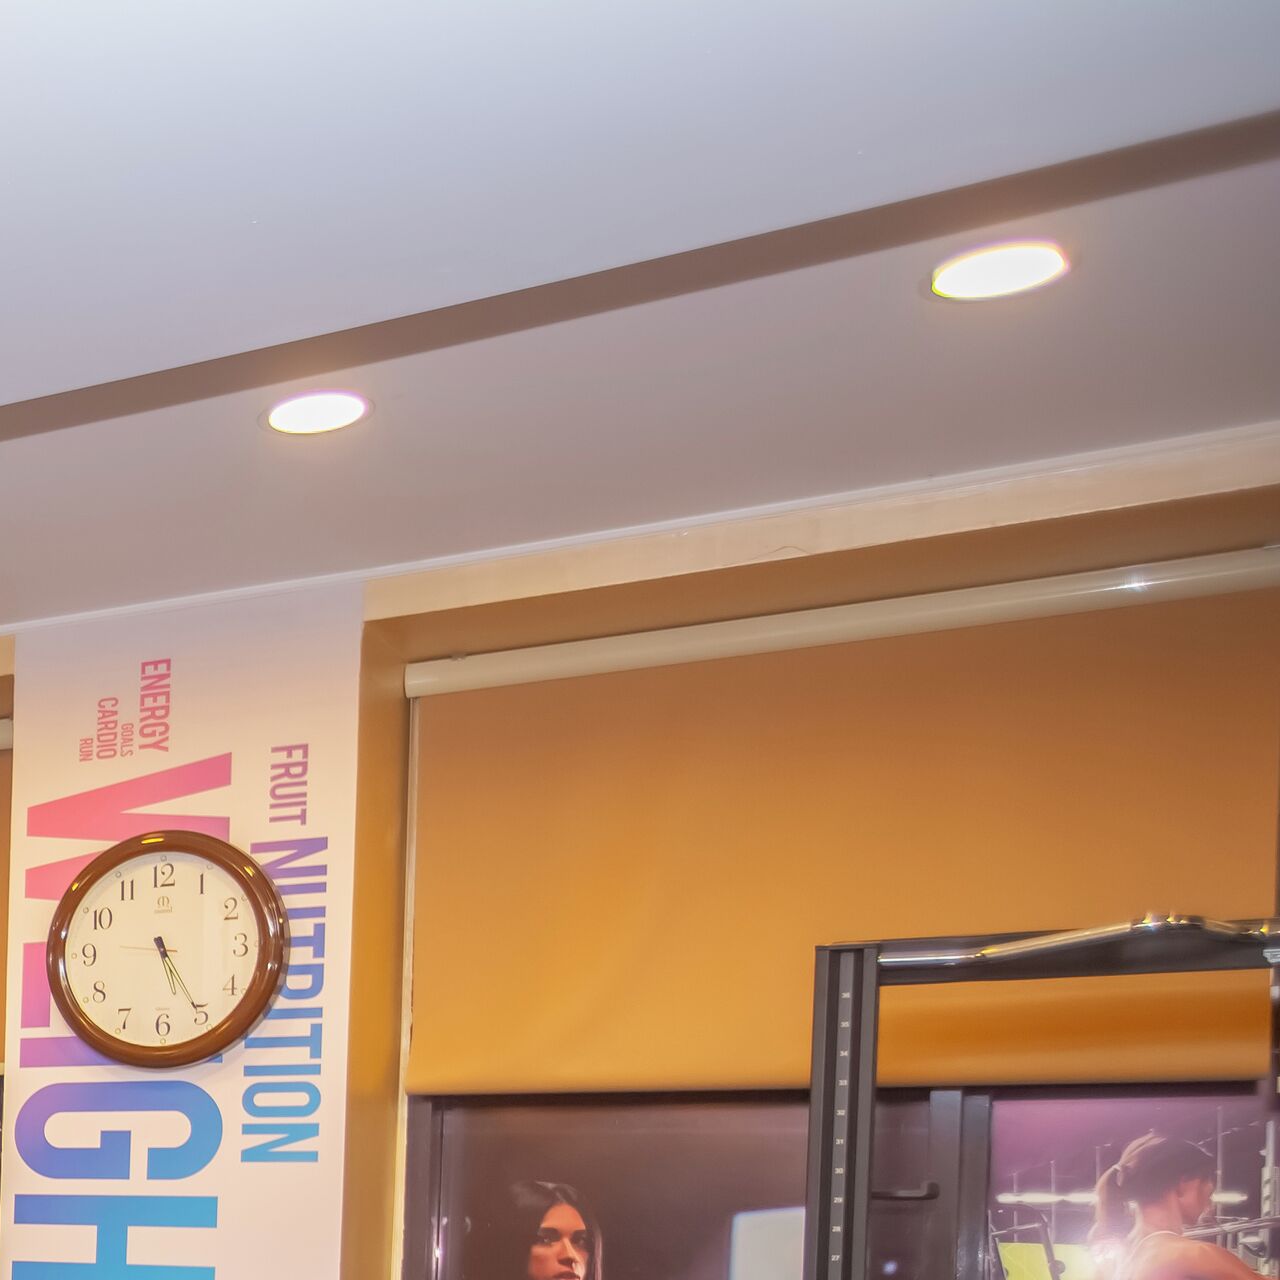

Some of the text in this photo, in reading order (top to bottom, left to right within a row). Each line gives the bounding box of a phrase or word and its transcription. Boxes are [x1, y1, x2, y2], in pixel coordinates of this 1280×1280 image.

[139, 658, 171, 752] ENERGY
[96, 697, 119, 760] CARDIO
[120, 723, 134, 757] GOALS
[79, 738, 93, 762] RUN
[268, 743, 309, 826] FRUIT
[153, 863, 175, 888] 12
[199, 873, 204, 894] 1
[120, 879, 135, 901] 11
[93, 907, 113, 930] 10
[223, 897, 239, 921] 2
[81, 943, 97, 966] 9
[233, 933, 248, 957] 3
[92, 981, 106, 1003] 8
[222, 974, 238, 996] 4
[117, 1008, 132, 1030] 7
[155, 1014, 170, 1036] 6
[194, 1003, 209, 1025] 5
